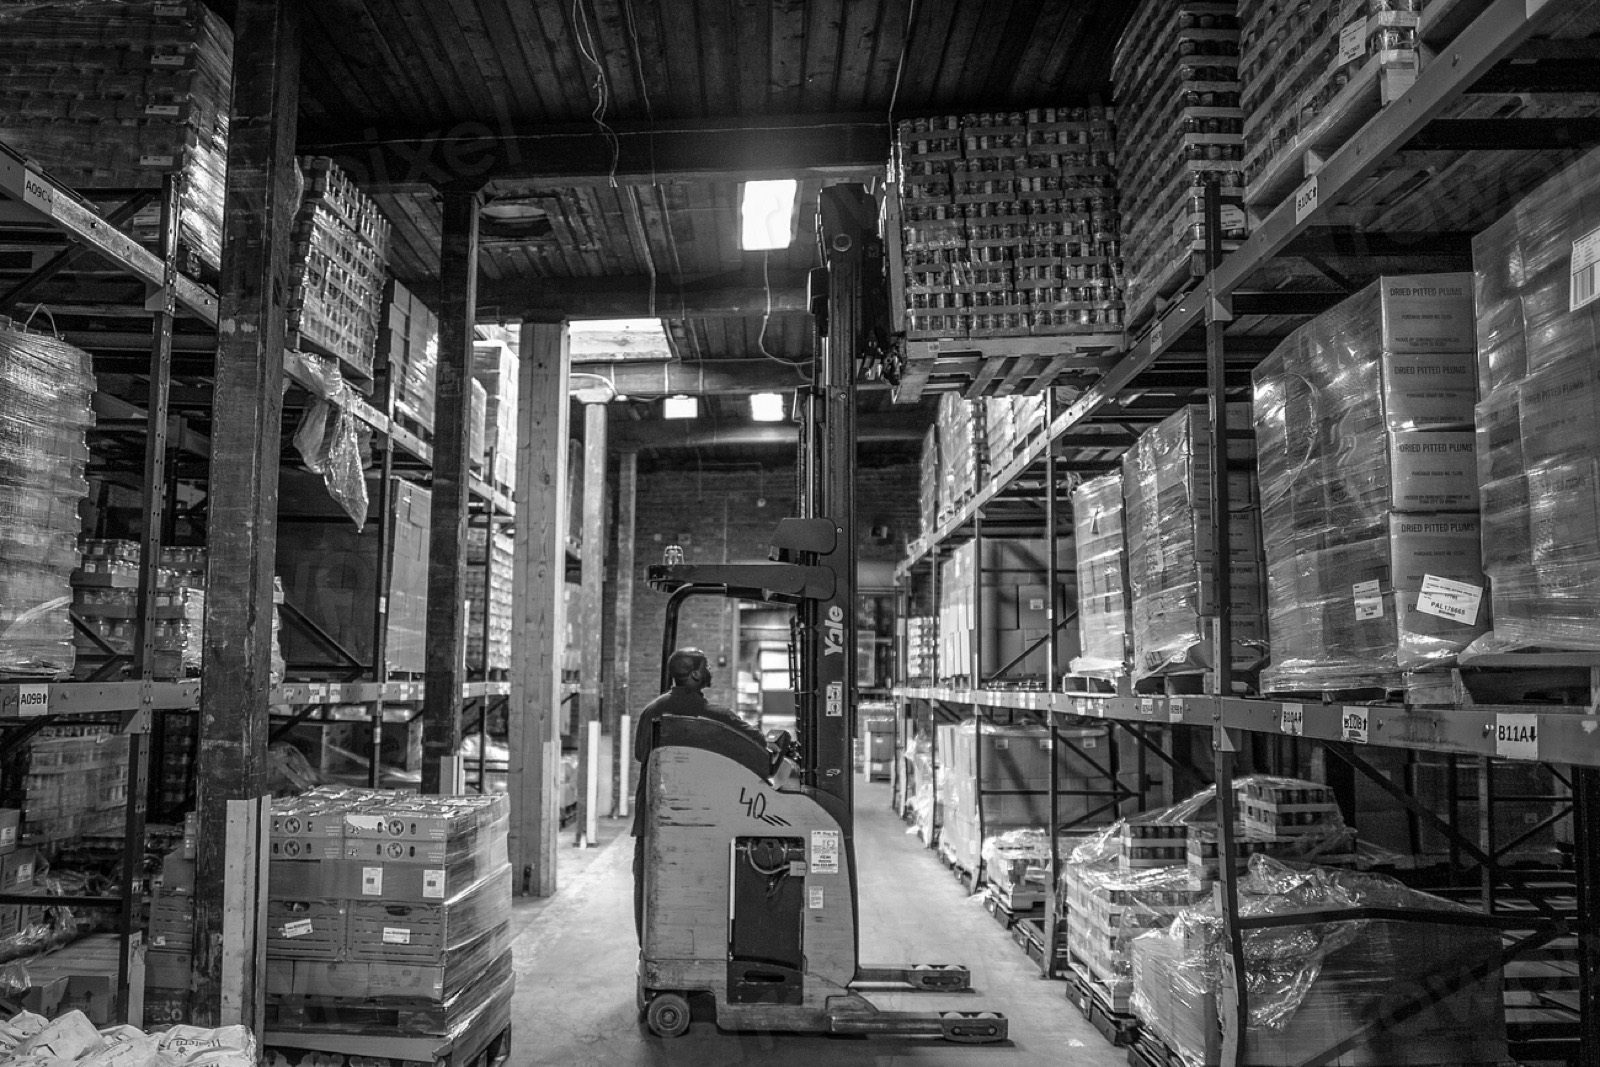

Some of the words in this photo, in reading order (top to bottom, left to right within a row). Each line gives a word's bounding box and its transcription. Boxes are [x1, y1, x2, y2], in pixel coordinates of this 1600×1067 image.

[1412, 287, 1437, 296] PITTED
[1439, 287, 1463, 296] PLUMS
[1416, 366, 1441, 375] PITTED
[1442, 365, 1467, 375] PLUMS
[1400, 443, 1421, 453] DRIED
[1422, 443, 1447, 453] PITTED
[1449, 443, 1474, 453] PLUMS
[1401, 523, 1423, 533] DRIED
[1424, 523, 1449, 533] PITTED
[1450, 523, 1475, 533] PLUMS
[825, 605, 844, 656] Yale
[1499, 725, 1529, 742] B11A
[739, 786, 767, 819] 40
